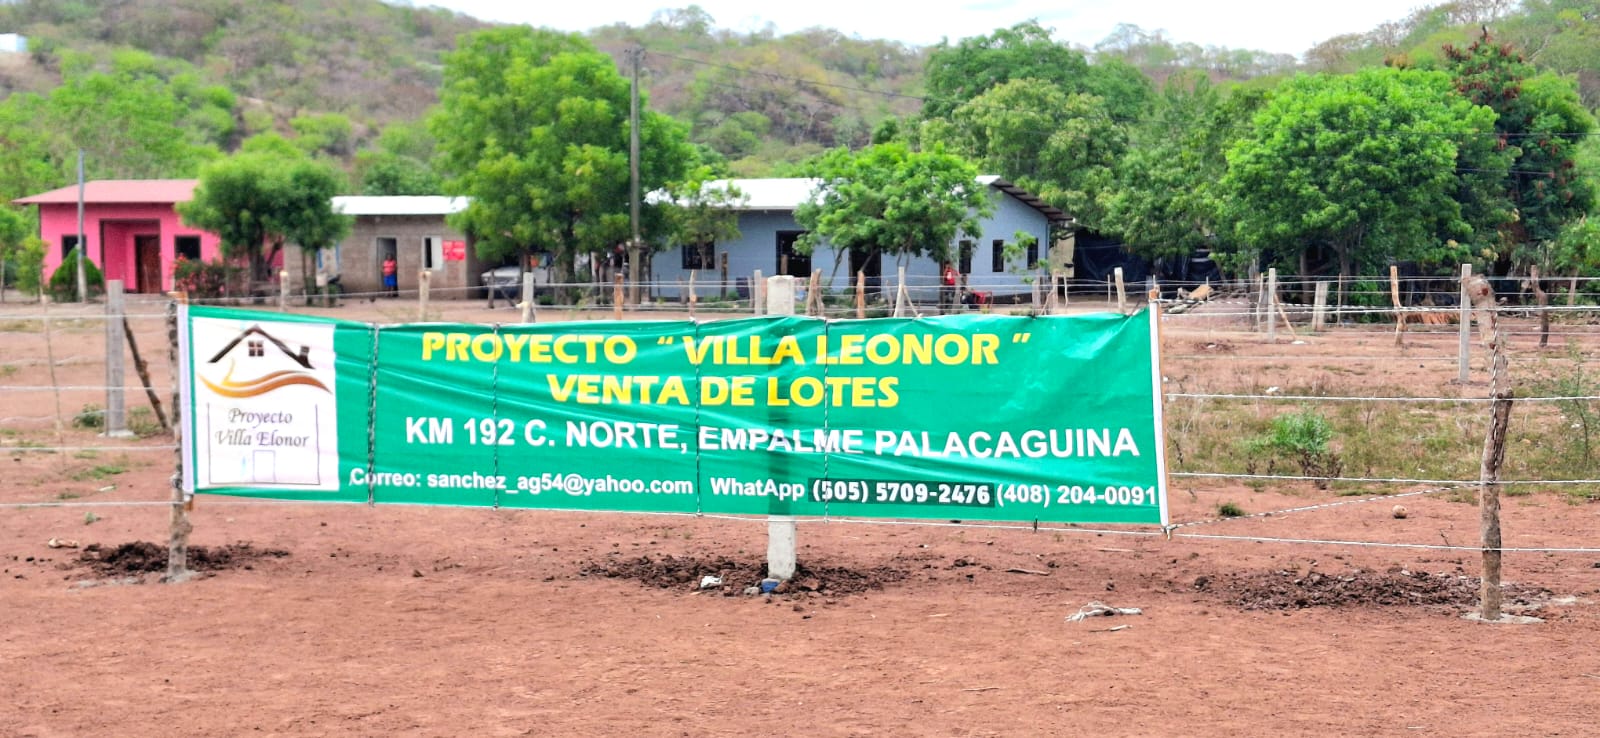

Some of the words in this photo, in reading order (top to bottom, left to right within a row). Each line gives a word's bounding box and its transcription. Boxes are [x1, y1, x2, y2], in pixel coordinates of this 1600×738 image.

[422, 332, 637, 364] PROYECTO
[682, 335, 805, 365] VILLA
[815, 333, 1000, 365] LEONOR
[546, 374, 690, 405] VENTA
[700, 376, 755, 406] DE
[767, 376, 899, 407] LOTES
[228, 407, 293, 429] Proyecto
[214, 429, 251, 446] Villa
[255, 429, 310, 447] Elonor
[405, 416, 453, 444] KM
[463, 418, 515, 445] 192
[524, 419, 555, 446] C.
[566, 421, 687, 454] NORTE,
[699, 425, 863, 454] EMPALME
[875, 427, 1140, 459] PALACAGUINA
[350, 468, 422, 487] Correo:
[427, 471, 693, 496] sanchez_ag54@yahoo.com
[710, 477, 805, 501] WhatApp
[812, 479, 869, 503] (505)
[876, 482, 990, 505] 5709-2476
[997, 484, 1050, 508] (408)
[1056, 485, 1155, 505] 204-0091
